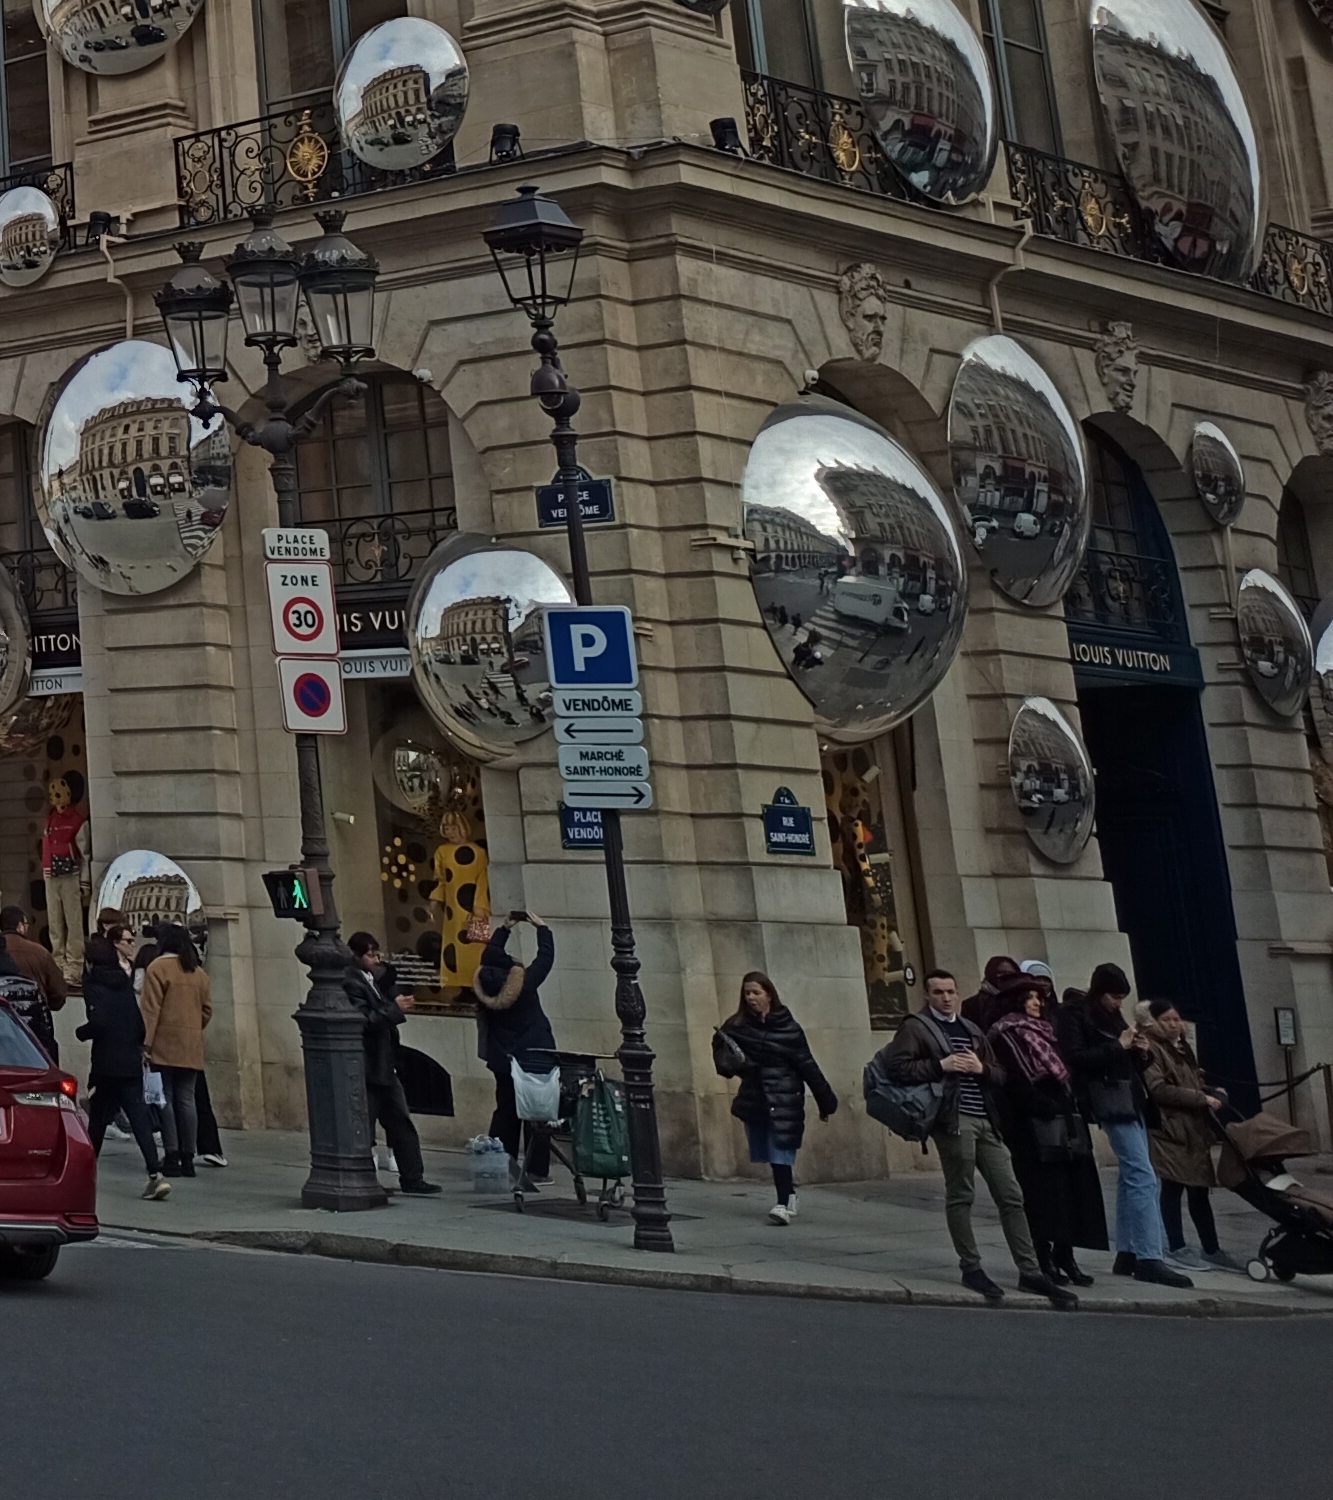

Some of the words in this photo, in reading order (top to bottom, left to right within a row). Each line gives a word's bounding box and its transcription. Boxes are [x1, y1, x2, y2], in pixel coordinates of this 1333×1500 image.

[557, 491, 590, 503] PCE
[277, 534, 316, 545] PLACE
[269, 546, 326, 557] VENDOME
[280, 575, 319, 587] ZONE
[291, 610, 316, 629] 30
[34, 633, 81, 653] ITTON
[570, 624, 607, 672] P
[1073, 643, 1112, 665] LOUIS
[1115, 648, 1171, 672] VUITTON
[342, 661, 375, 674] OUIS
[31, 679, 62, 691] ITTON
[562, 696, 634, 712] VENDÔME
[579, 749, 625, 761] MARCHÉ
[565, 764, 643, 777] SAINT-HONORÉ
[567, 826, 604, 839] VENDÔ
